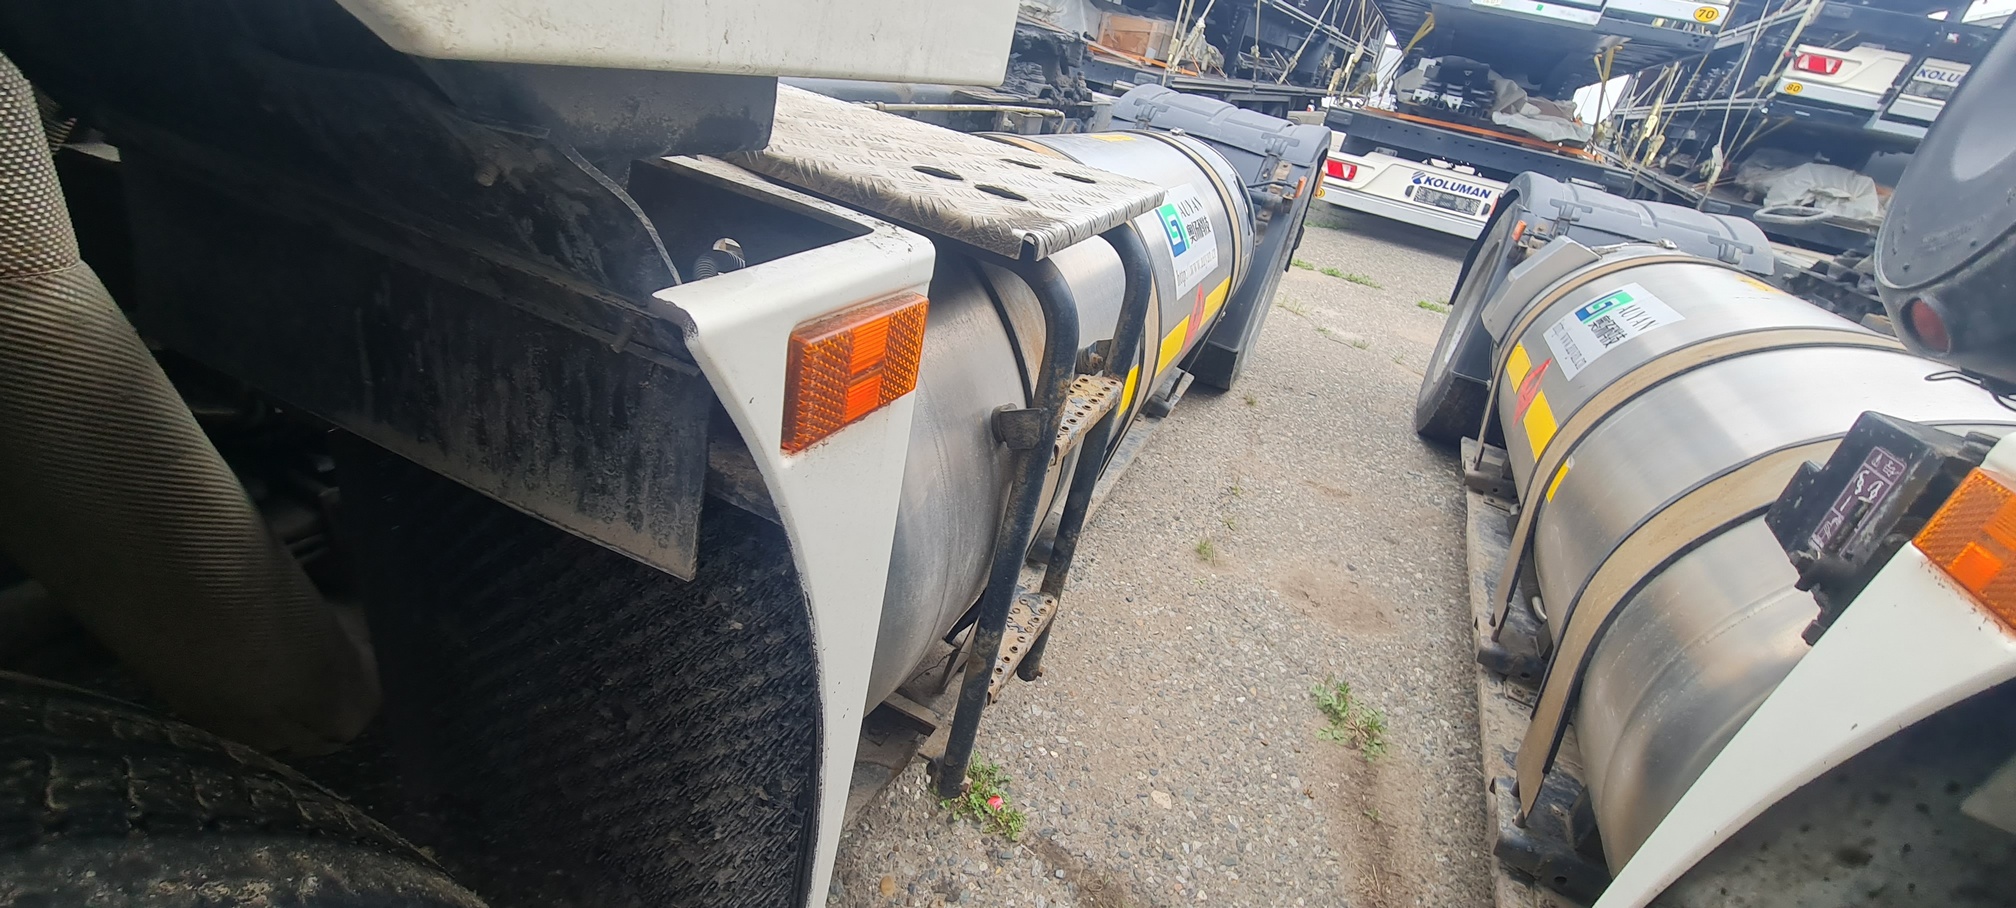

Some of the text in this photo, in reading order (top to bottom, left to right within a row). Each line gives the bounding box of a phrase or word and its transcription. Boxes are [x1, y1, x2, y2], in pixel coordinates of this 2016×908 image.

[1698, 9, 1715, 20] 70
[1916, 67, 1963, 84] KOLU
[1786, 84, 1801, 93] 80
[1423, 176, 1492, 199] KOLUMAN
[1177, 195, 1204, 219] AUYAN
[1616, 304, 1659, 332] AUYAN
